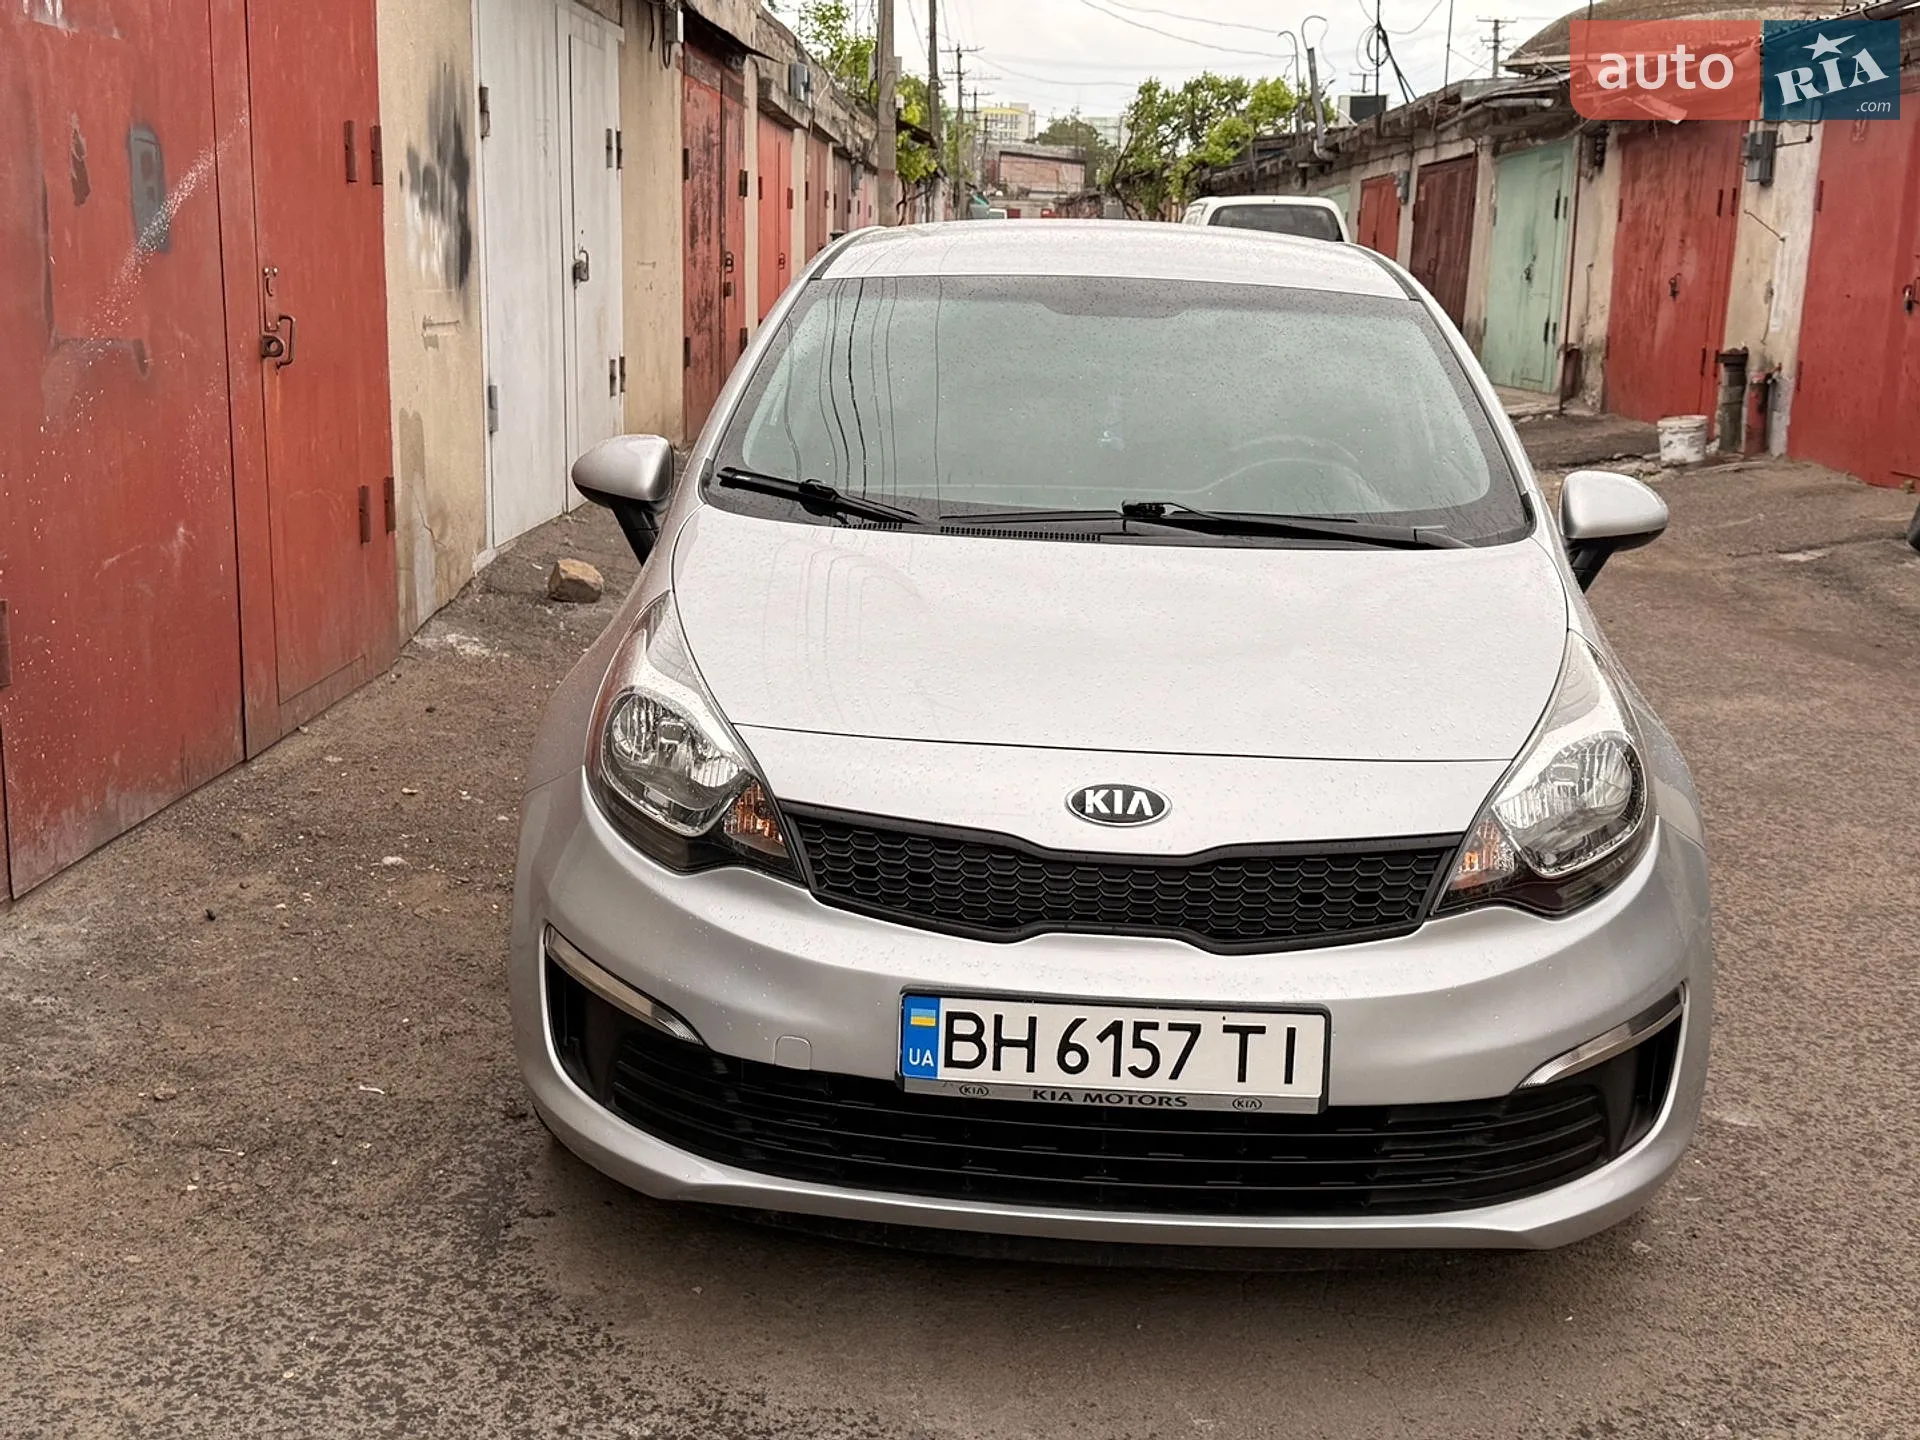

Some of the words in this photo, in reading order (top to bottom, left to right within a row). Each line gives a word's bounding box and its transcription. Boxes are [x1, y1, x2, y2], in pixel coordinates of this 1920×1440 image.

[1084, 789, 1154, 816] KIA
[943, 1010, 1037, 1073] BH
[1056, 1018, 1201, 1080] 6157
[908, 1047, 935, 1067] UA
[962, 1085, 986, 1096] KIA
[1032, 1089, 1073, 1102] KIA
[1082, 1092, 1188, 1108] MOTORS
[1235, 1098, 1259, 1109] KIA
